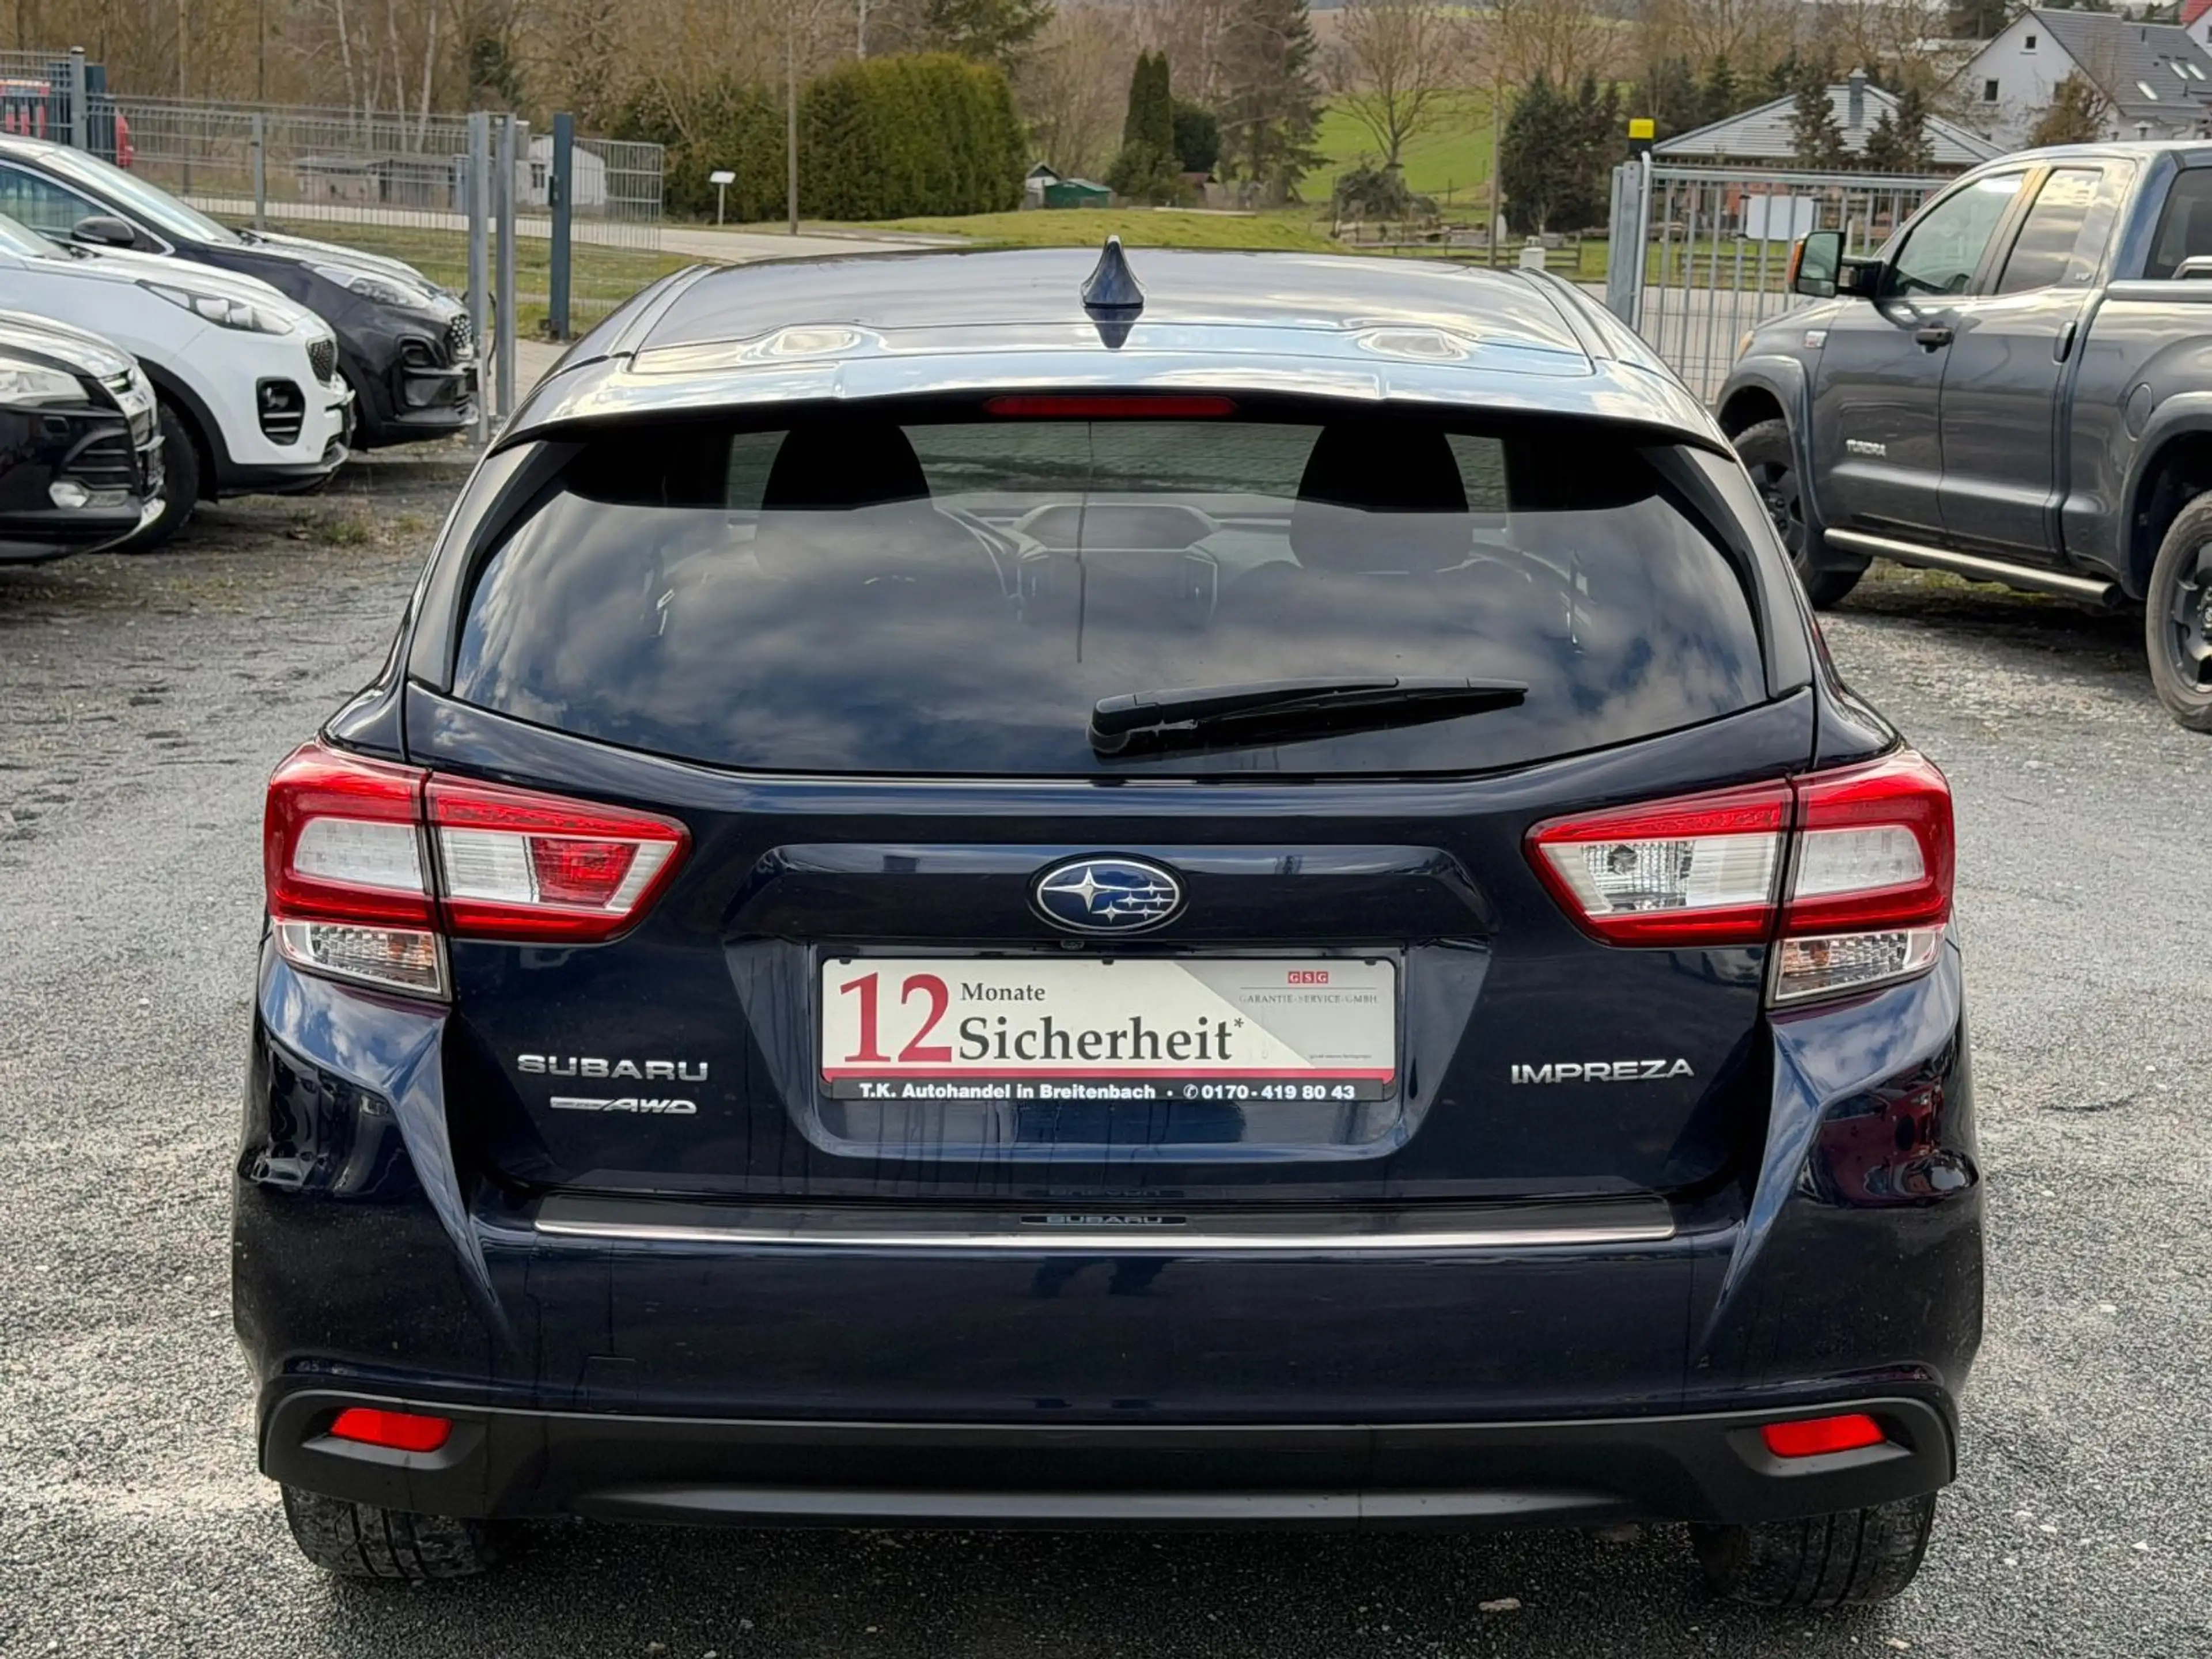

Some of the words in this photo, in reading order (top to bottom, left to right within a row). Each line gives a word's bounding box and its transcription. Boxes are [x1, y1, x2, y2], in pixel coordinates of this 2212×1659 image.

[1289, 972, 1328, 983] GSG
[960, 983, 1045, 1001] Monate
[840, 972, 952, 1062] 12
[518, 1054, 709, 1081] SUBARU
[1511, 1058, 1695, 1084] IMPREZA
[859, 1083, 896, 1099] T.K.
[902, 1083, 1010, 1099] Autohandel
[1017, 1084, 1034, 1099] in
[1039, 1083, 1156, 1099] Breitenbach
[1302, 1085, 1326, 1100] 80
[1331, 1085, 1355, 1100] 43
[603, 1099, 698, 1114] AWD
[1046, 1215, 1162, 1224] SUBARU
